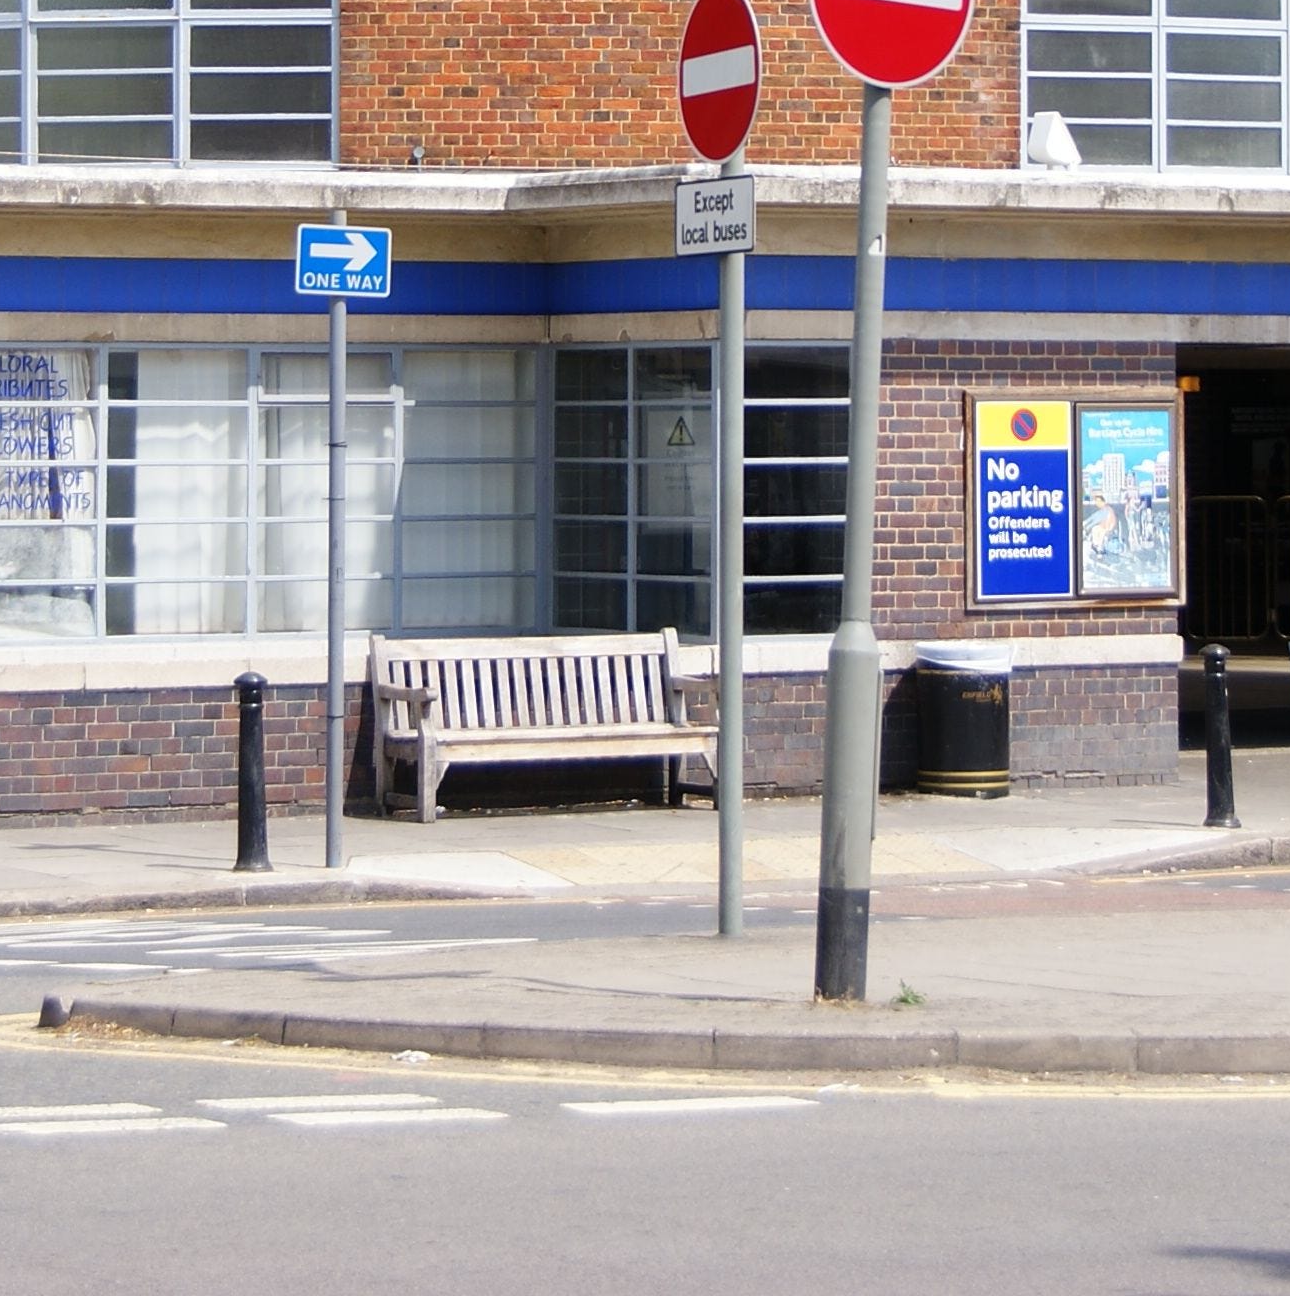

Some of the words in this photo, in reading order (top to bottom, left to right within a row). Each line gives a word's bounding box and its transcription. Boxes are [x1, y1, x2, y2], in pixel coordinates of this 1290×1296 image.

[694, 188, 734, 215] Except
[681, 221, 709, 245] local
[713, 220, 747, 242] buses
[303, 271, 341, 288] ONE
[346, 274, 383, 290] WAY
[987, 457, 1020, 481] No
[62, 470, 86, 489] OF
[987, 484, 1064, 514] parking
[988, 515, 1051, 530] Offenders
[988, 530, 1010, 545] will
[1012, 530, 1028, 545] be
[988, 544, 1053, 562] prosecuted
